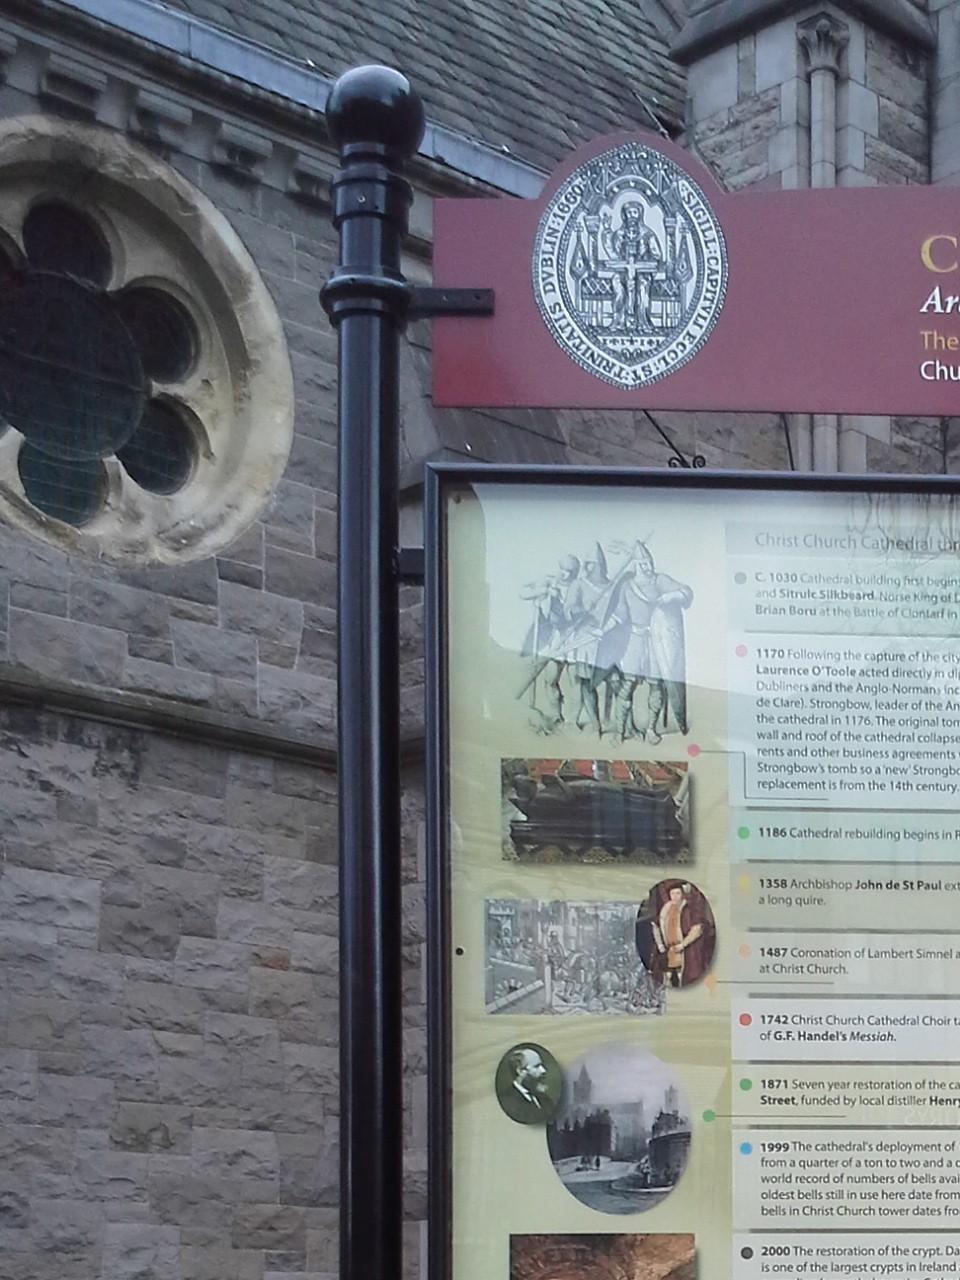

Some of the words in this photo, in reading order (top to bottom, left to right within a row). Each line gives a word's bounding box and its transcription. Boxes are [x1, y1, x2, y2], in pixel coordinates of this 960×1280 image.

[920, 331, 959, 351] The
[758, 779, 826, 790] replacement
[829, 780, 837, 790] is
[840, 780, 865, 790] from
[869, 780, 886, 790] the
[890, 781, 913, 791] 14th
[916, 783, 959, 794] century.
[759, 828, 787, 837] 1186
[790, 828, 842, 838] Cathedral
[845, 829, 900, 842] rebuilding
[904, 829, 939, 841] begins
[942, 830, 952, 839] in
[760, 879, 787, 888] 1358
[790, 879, 852, 890] Archbishop
[856, 880, 883, 889] John
[886, 880, 900, 889] de
[903, 881, 914, 890] St
[917, 880, 941, 890] Paul
[768, 895, 792, 907] long
[795, 896, 825, 907] quire.
[761, 948, 787, 957] 1487
[791, 948, 851, 958] Coronation
[854, 948, 865, 958] of
[868, 949, 913, 958] Lambert
[917, 949, 952, 959] Simnel
[760, 965, 770, 973] at
[773, 964, 804, 974] Christ
[807, 964, 848, 974] Church.
[761, 1015, 788, 1024] 1742
[791, 1015, 823, 1025] Christ
[826, 1015, 864, 1025] Church
[867, 1016, 919, 1025] Cathedral
[922, 1016, 951, 1026] Choir
[760, 1031, 771, 1040] of
[774, 1031, 795, 1040] G.F.
[850, 1032, 896, 1041] Messiah.
[761, 1080, 787, 1089] 1871
[793, 1079, 825, 1089] Seven
[828, 1082, 850, 1091] year
[854, 1081, 912, 1090] restoration
[915, 1080, 926, 1089] of
[929, 1080, 946, 1089] the
[761, 1095, 798, 1106] Street,
[801, 1095, 840, 1105] funded
[844, 1096, 857, 1108] by
[860, 1096, 884, 1105] local
[888, 1096, 927, 1105] distiller
[760, 1143, 789, 1152] 1999
[794, 1141, 812, 1151] The
[876, 1142, 941, 1154] deployment
[944, 1141, 955, 1152] of
[761, 1173, 792, 1183] world
[796, 1174, 830, 1183] record
[833, 1173, 843, 1183] of
[847, 1174, 895, 1184] numbers
[898, 1173, 908, 1184] of
[912, 1174, 936, 1184] bells
[762, 1247, 790, 1256] 2000
[794, 1246, 813, 1256] The
[817, 1247, 875, 1256] restoration
[878, 1245, 889, 1256] of
[892, 1246, 910, 1256] the
[912, 1247, 943, 1258] crypt.
[762, 1263, 770, 1272] is
[796, 1262, 807, 1272] of
[810, 1262, 828, 1272] the
[831, 1262, 868, 1275] largest
[870, 1263, 904, 1275] crypts
[907, 1263, 916, 1272] in
[920, 1262, 956, 1272] Ireland
